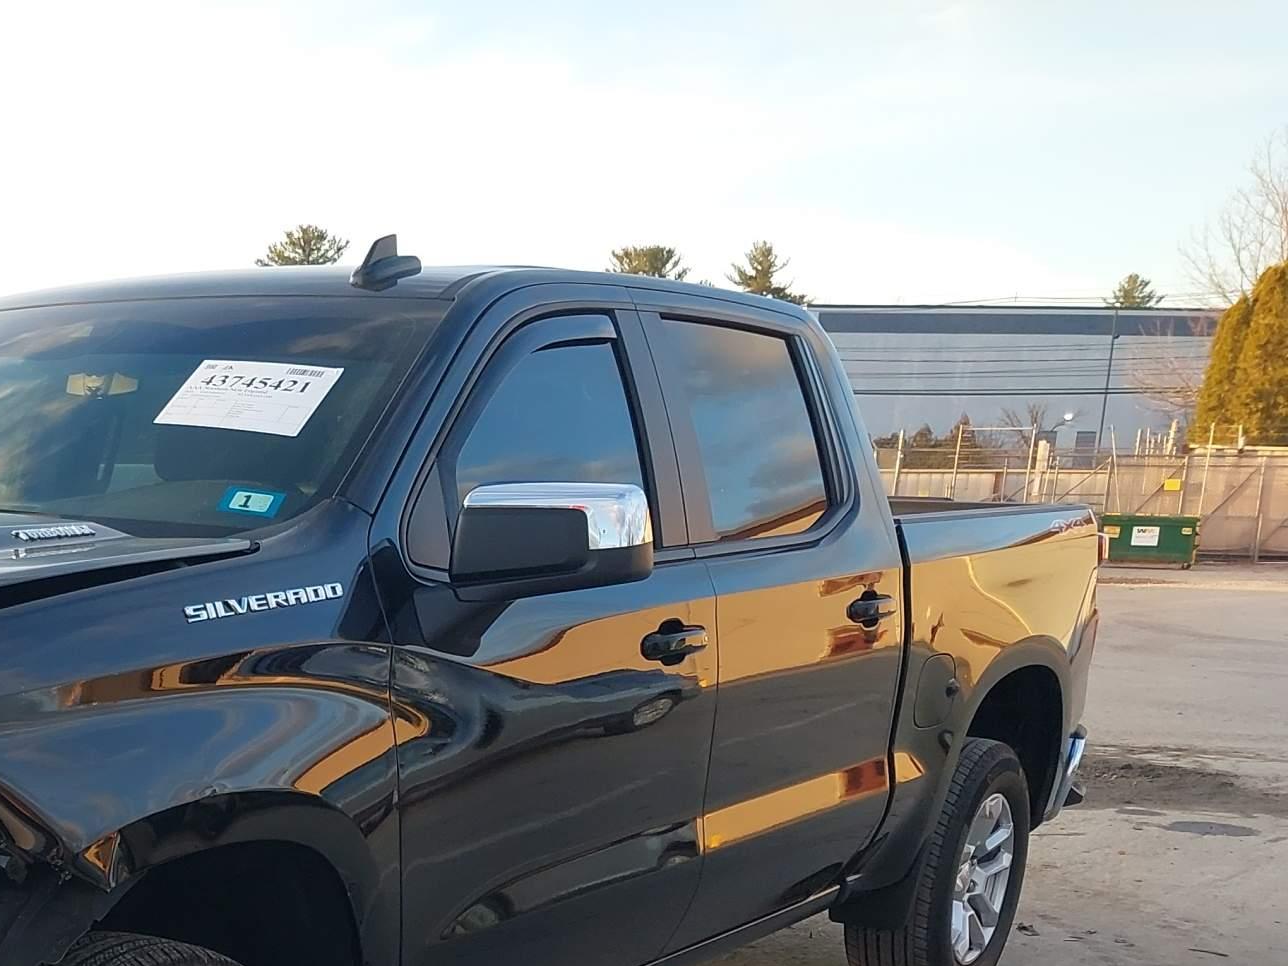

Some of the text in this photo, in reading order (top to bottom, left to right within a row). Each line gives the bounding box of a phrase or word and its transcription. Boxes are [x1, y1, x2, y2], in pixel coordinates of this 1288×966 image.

[200, 373, 312, 393] 43745421
[238, 494, 252, 509] 1
[184, 582, 344, 624] SILVERADO
